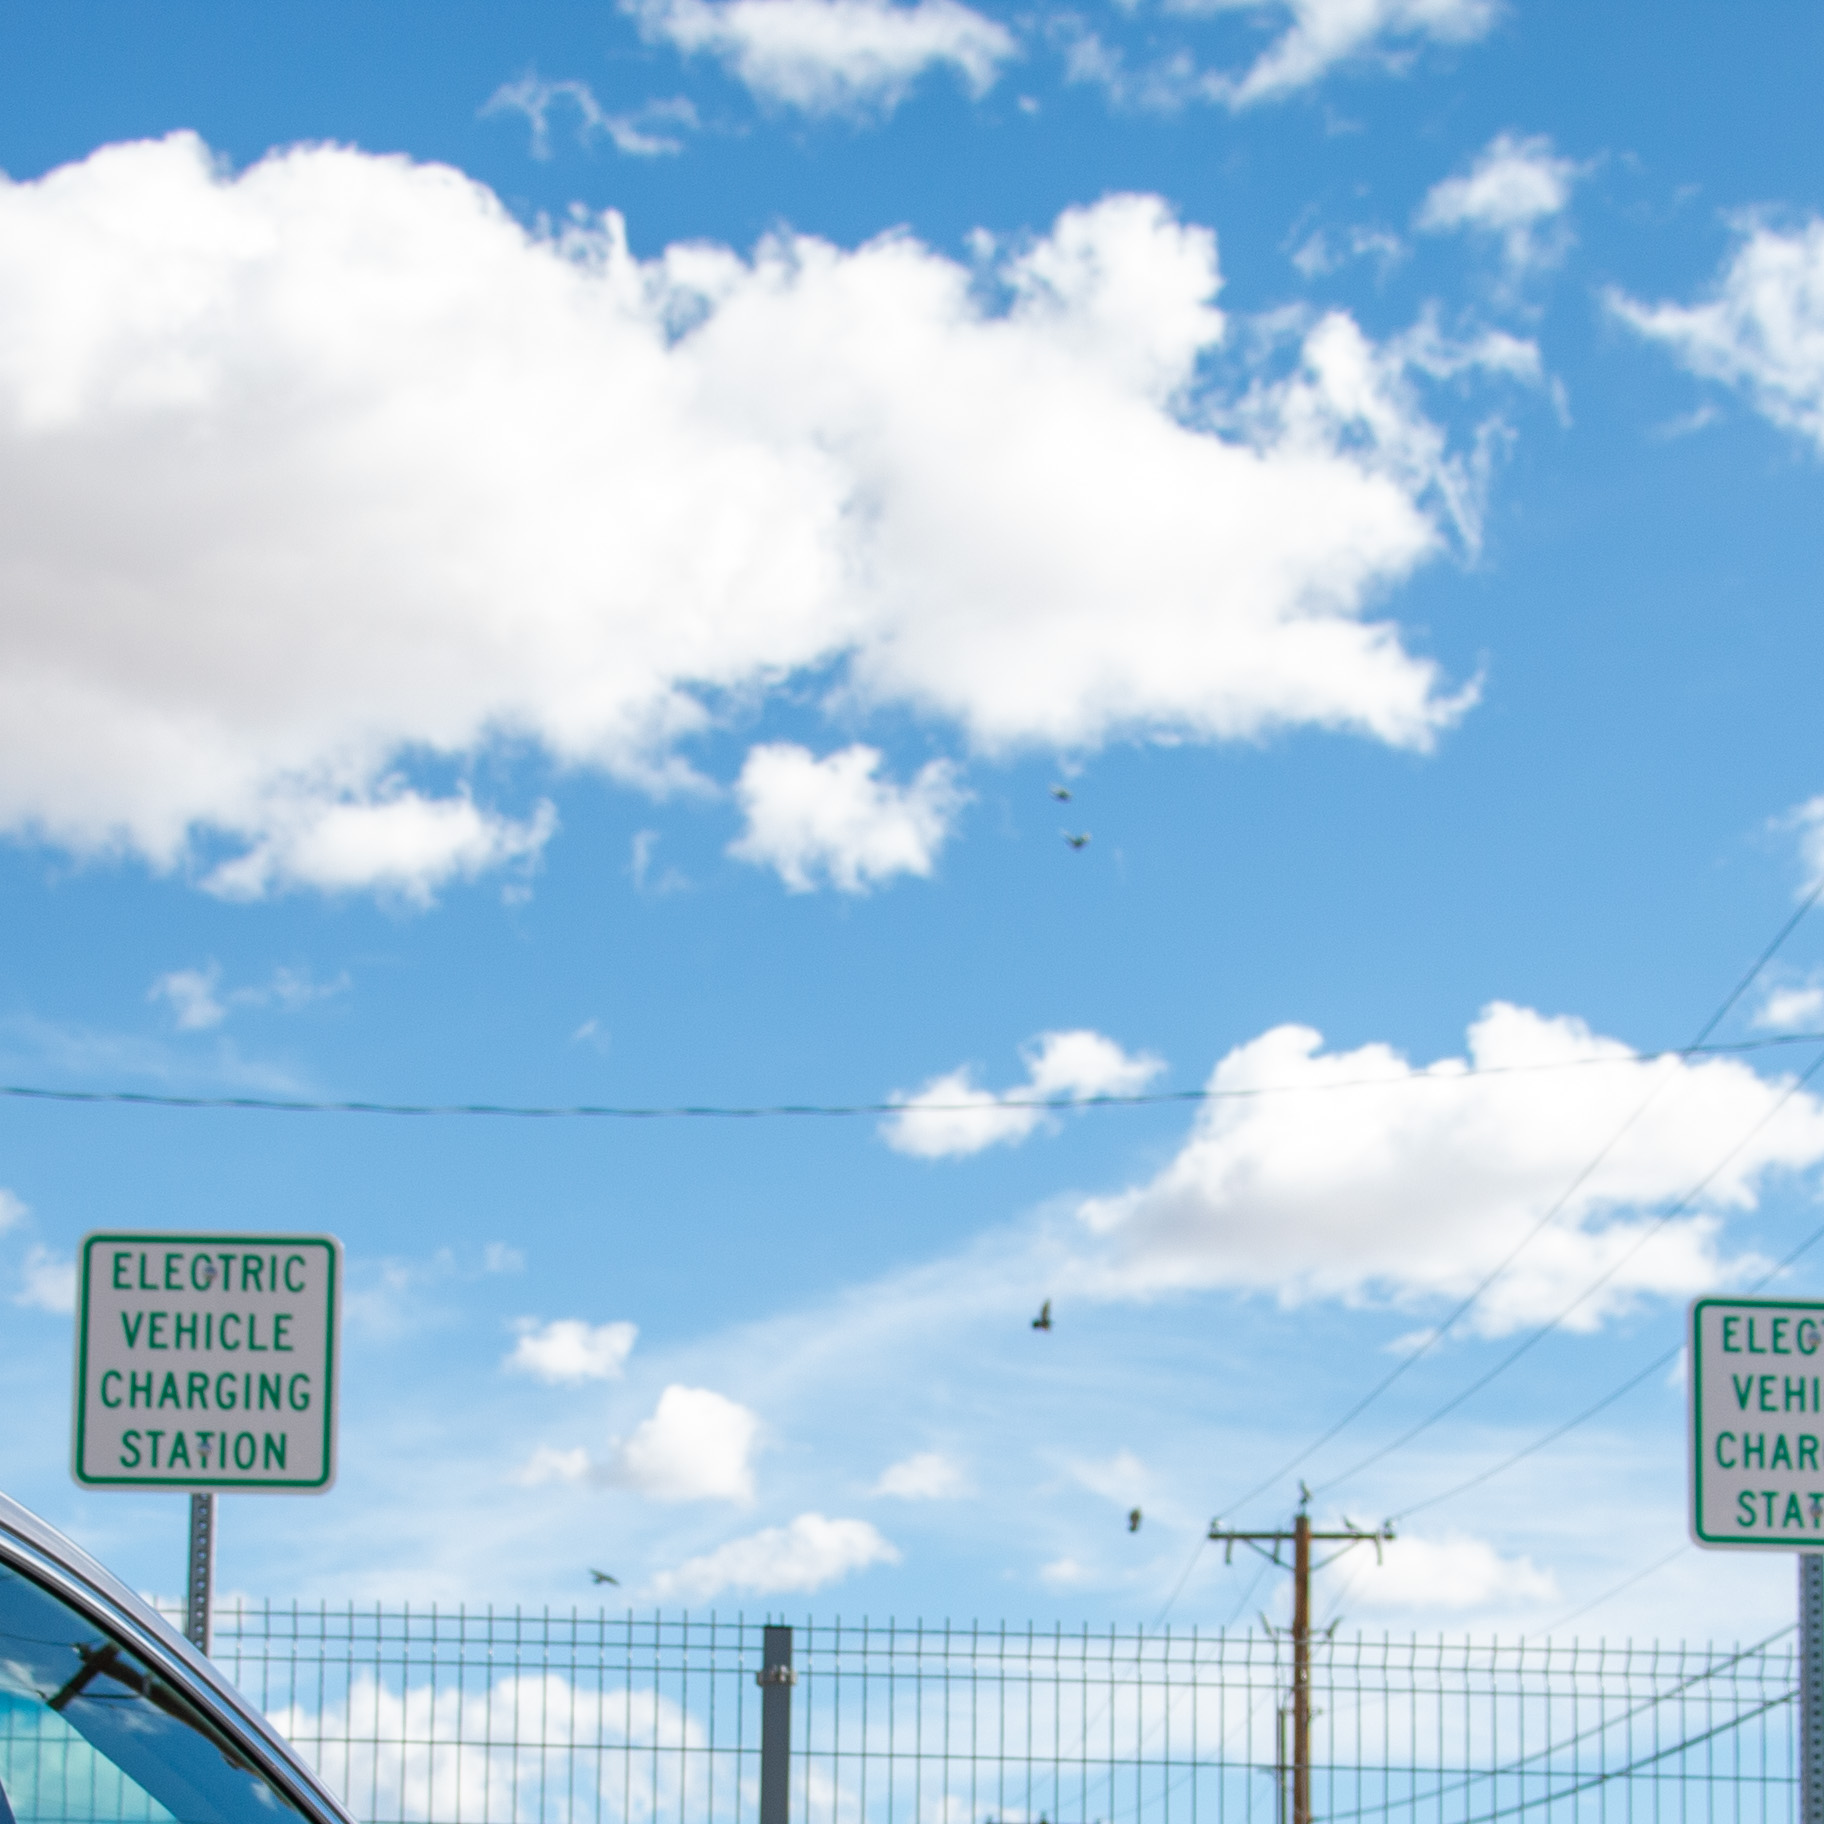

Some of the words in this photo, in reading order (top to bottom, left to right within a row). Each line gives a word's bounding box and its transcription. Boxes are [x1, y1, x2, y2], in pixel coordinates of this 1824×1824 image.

[112, 1252, 306, 1293] ELECTRIC
[120, 1311, 294, 1351] VEHICLE
[100, 1370, 311, 1411] CHARGING
[119, 1430, 287, 1471] STATION
